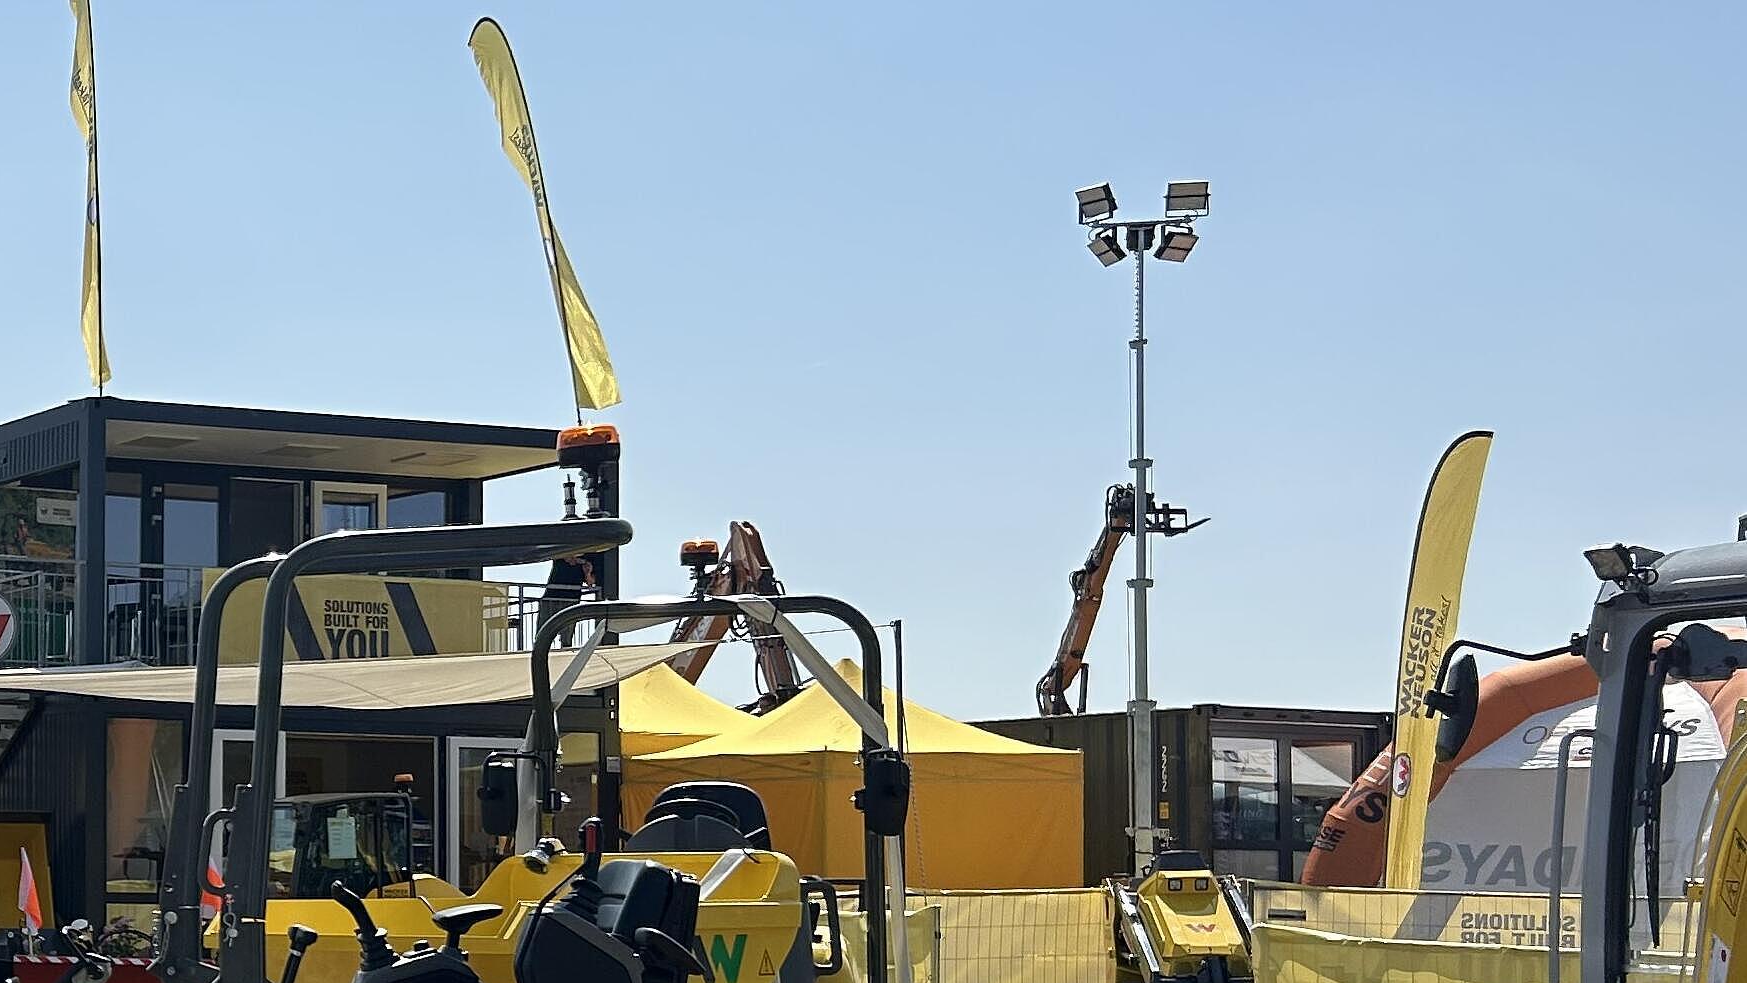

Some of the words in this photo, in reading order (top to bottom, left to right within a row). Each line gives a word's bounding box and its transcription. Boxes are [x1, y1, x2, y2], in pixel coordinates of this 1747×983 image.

[324, 600, 389, 614] SOLUTIONS
[324, 614, 359, 628] BUILT
[365, 616, 389, 629] FOR
[325, 628, 389, 659] YOU
[1399, 606, 1426, 716] WACKER
[1410, 607, 1437, 719] NEUSON
